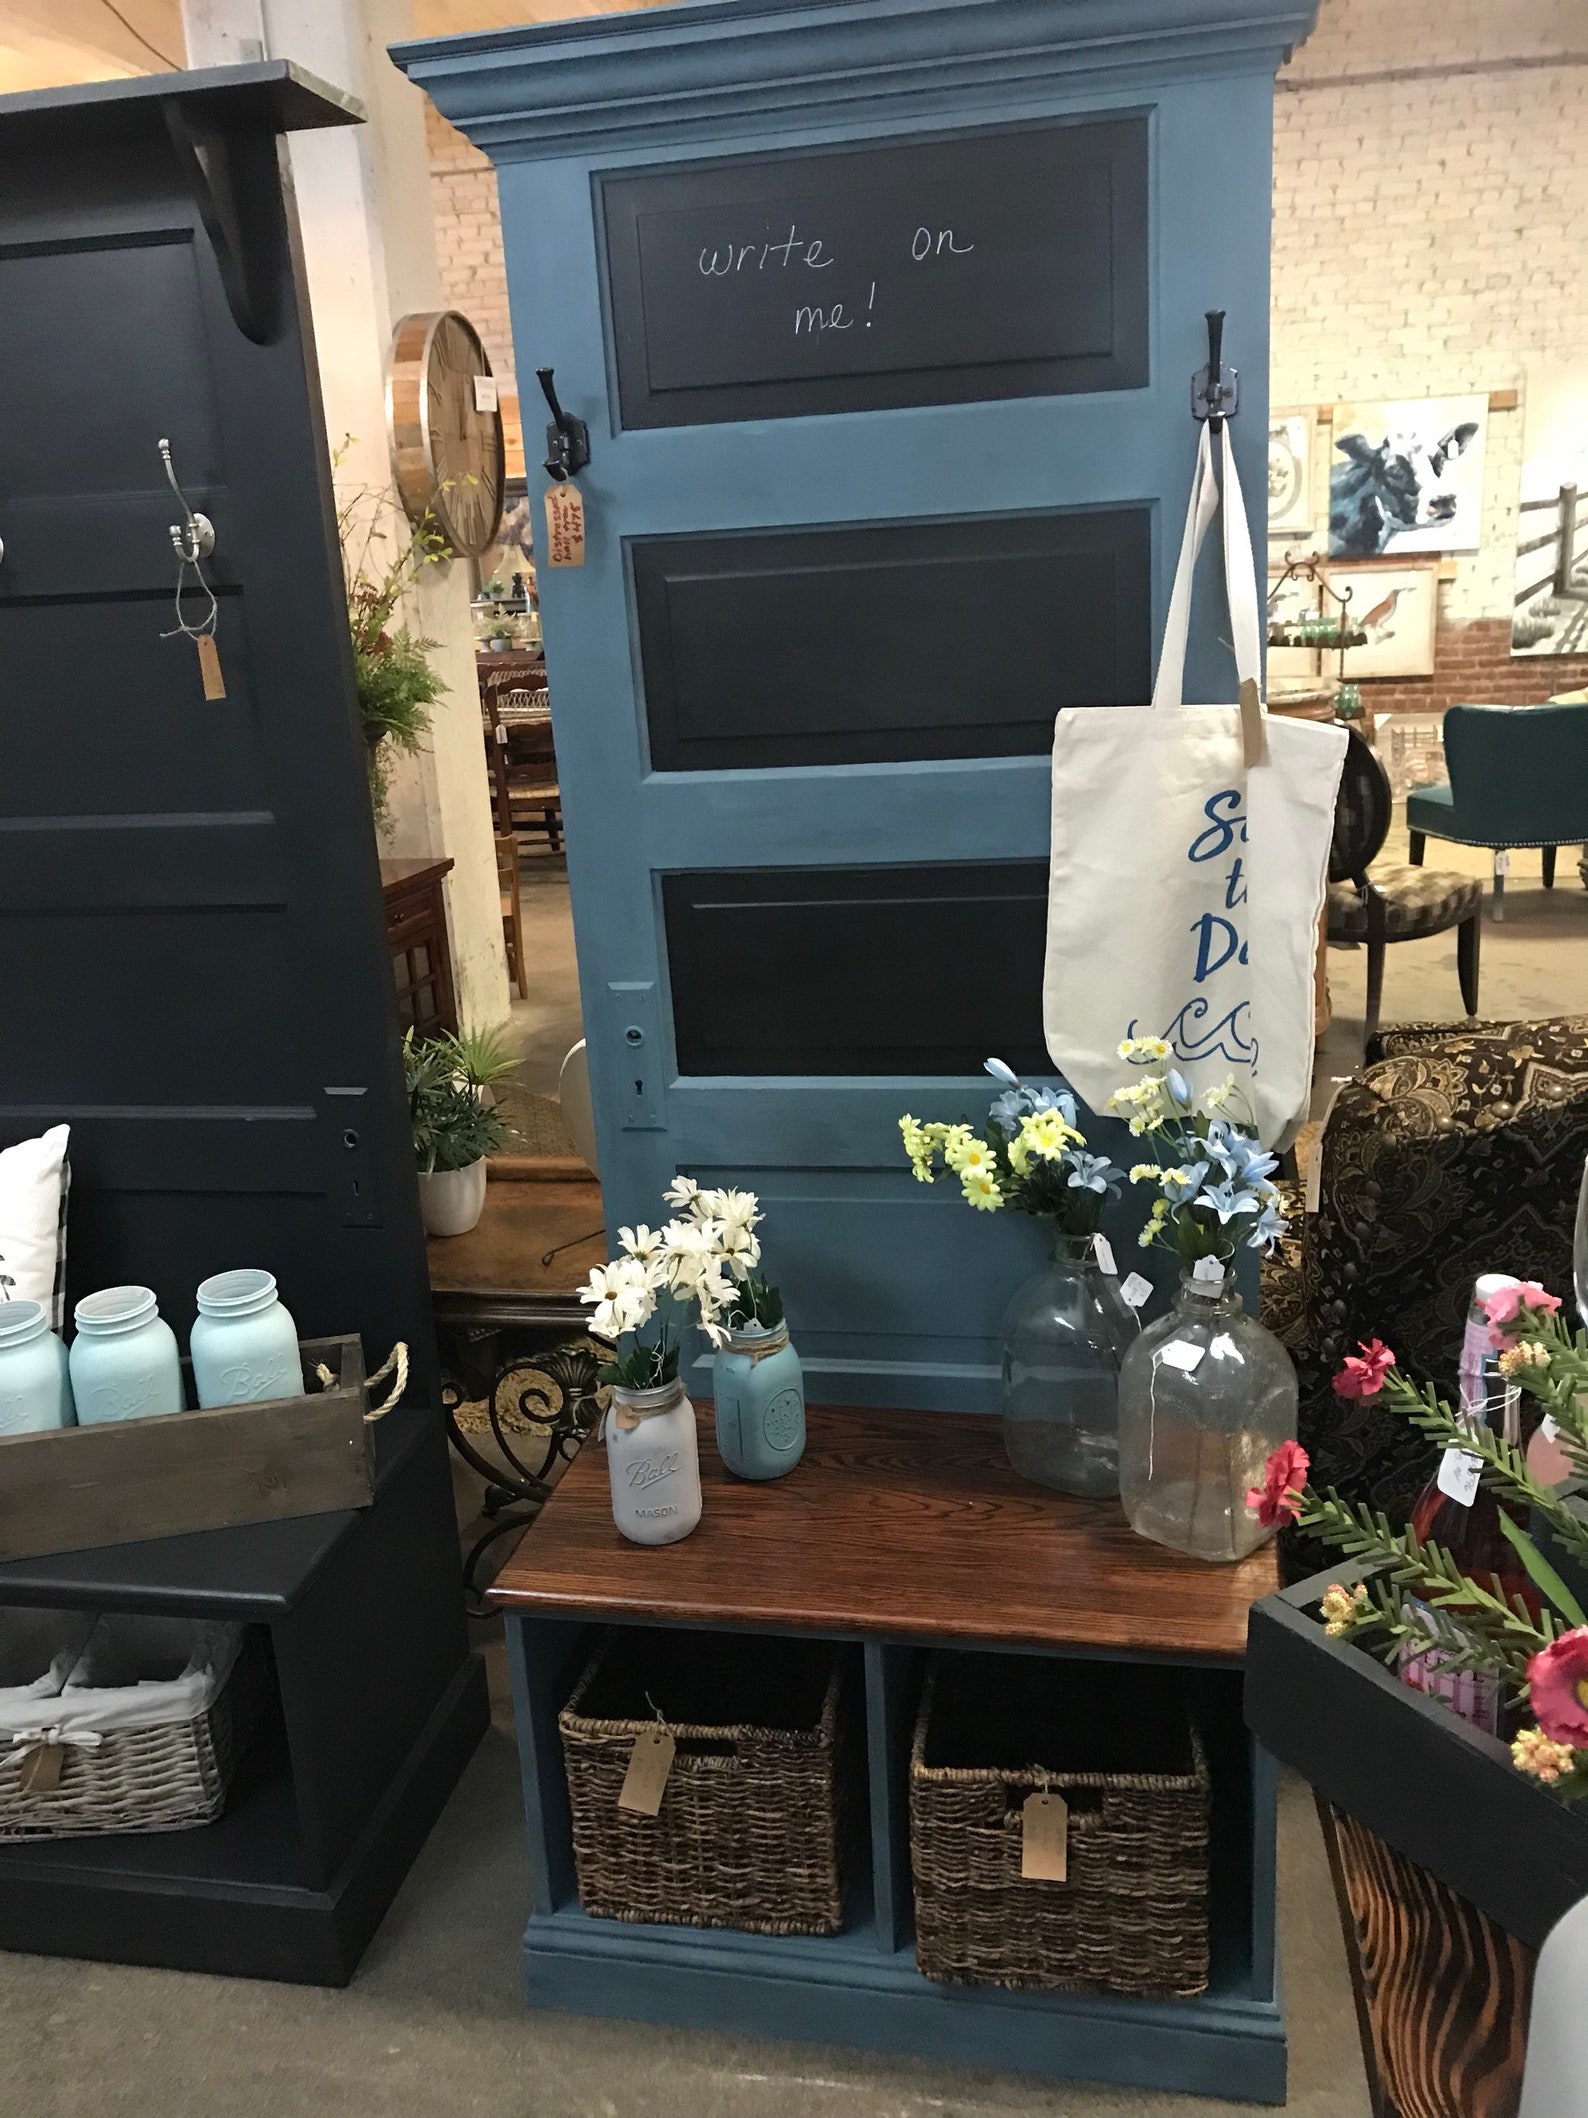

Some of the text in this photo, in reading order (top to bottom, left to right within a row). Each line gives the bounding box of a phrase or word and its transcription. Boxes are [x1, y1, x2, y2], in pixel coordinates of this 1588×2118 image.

[699, 222, 974, 275] write on
[795, 281, 876, 334] me!
[625, 1452, 683, 1490] Ball
[635, 1505, 678, 1519] MASON
